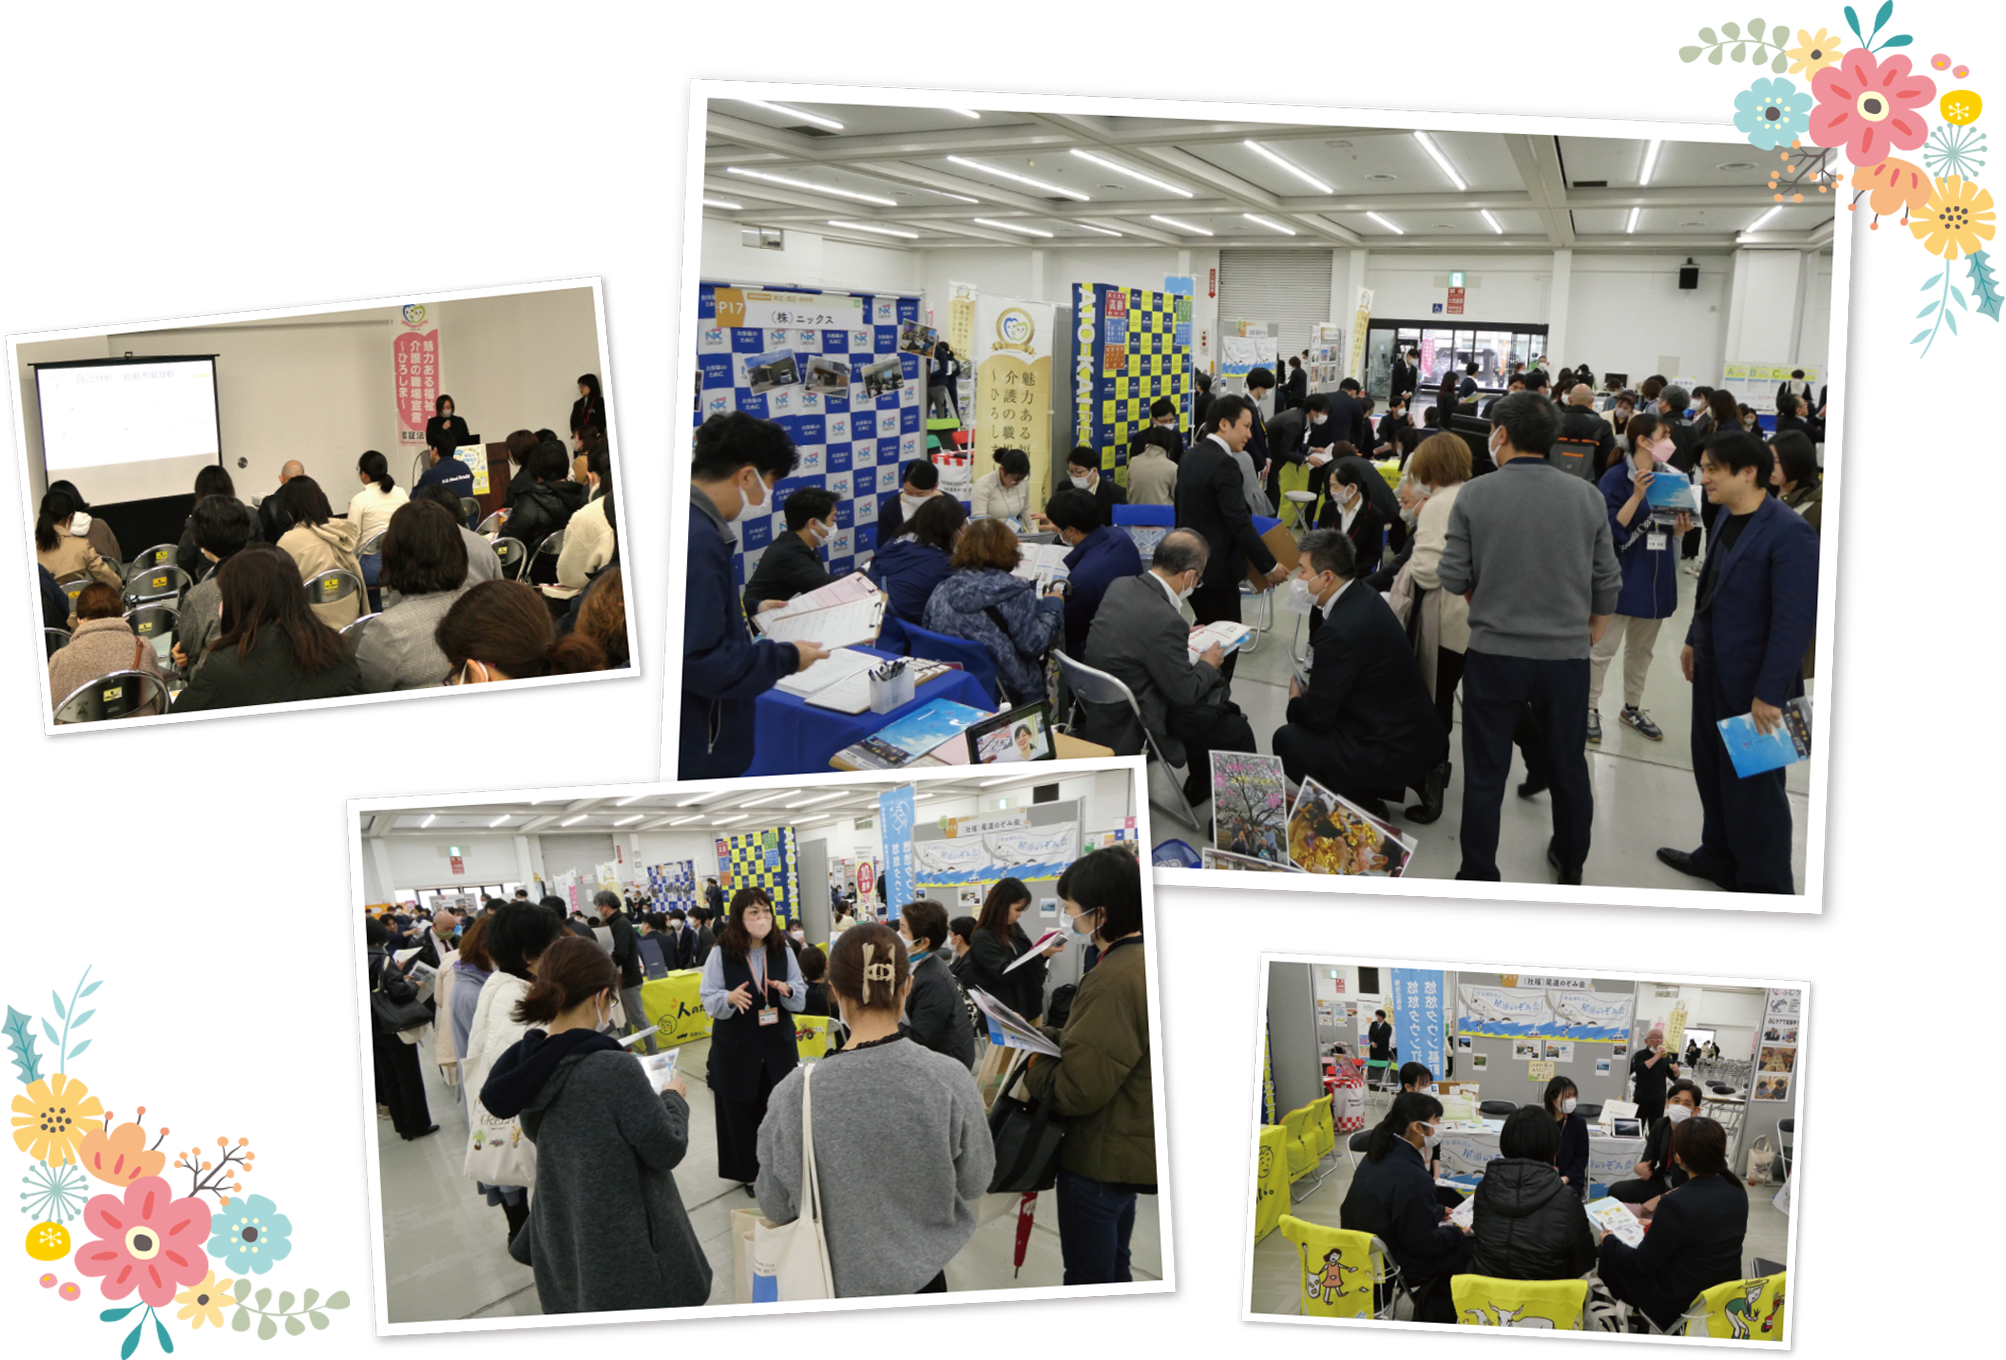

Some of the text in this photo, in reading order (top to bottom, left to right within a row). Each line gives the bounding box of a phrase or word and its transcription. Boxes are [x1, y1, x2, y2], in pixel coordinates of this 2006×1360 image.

[718, 302, 744, 314] P17
[1076, 286, 1097, 405] ATO-KAI
[784, 830, 800, 904] ATO-KAI
[1494, 999, 1540, 1012] 尾道のぞみ会
[1581, 1003, 1626, 1016] 尾道のぞみ会
